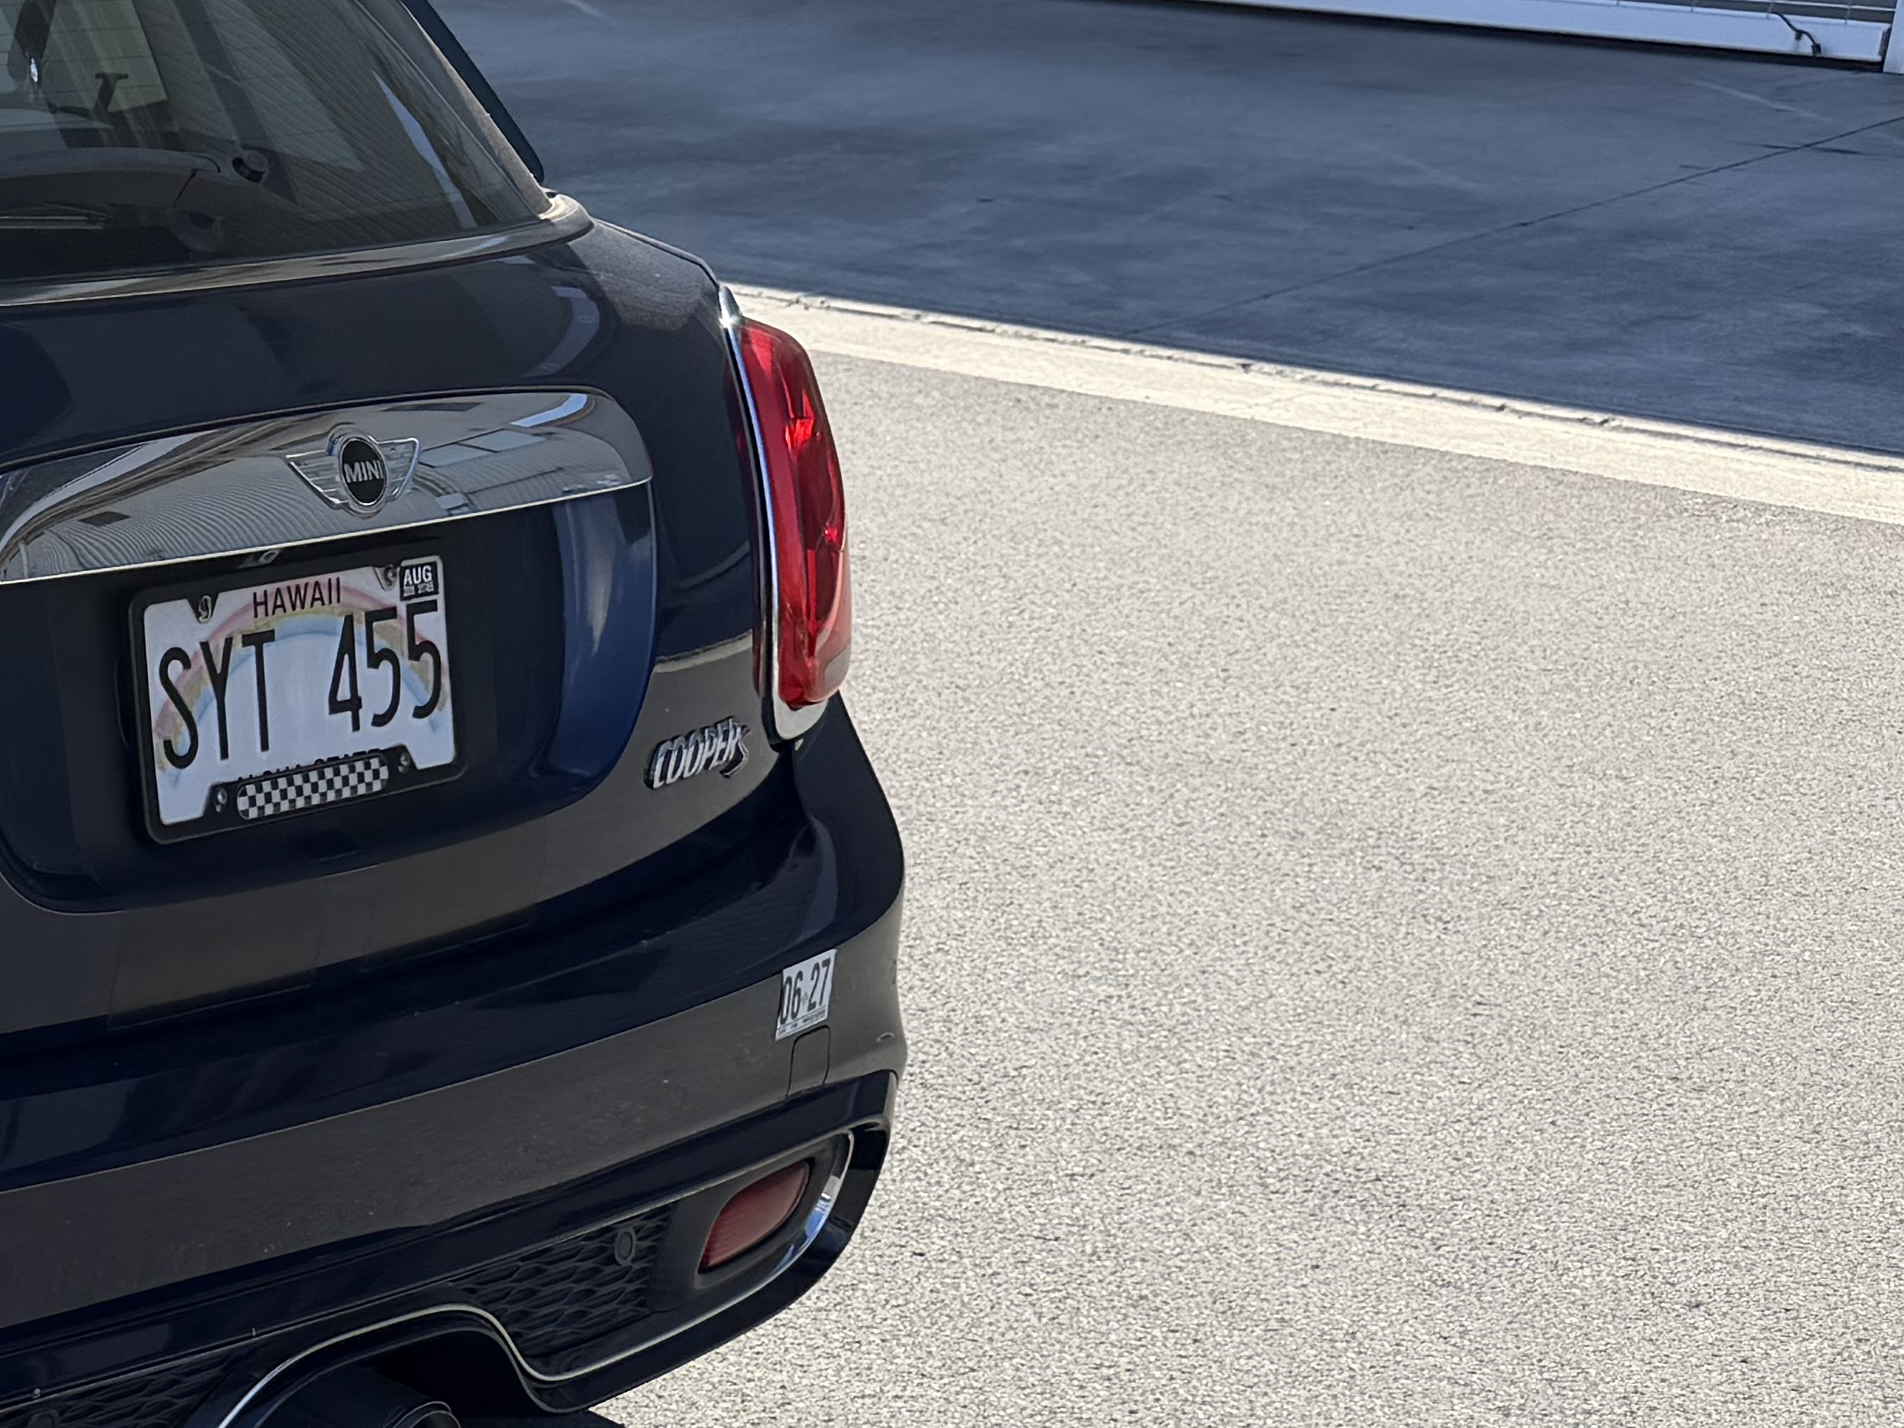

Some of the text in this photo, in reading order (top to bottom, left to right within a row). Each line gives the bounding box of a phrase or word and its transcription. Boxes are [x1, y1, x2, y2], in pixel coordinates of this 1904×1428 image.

[343, 459, 384, 483] MINI
[404, 564, 432, 585] AUG
[252, 577, 342, 619] HAWAII
[158, 599, 442, 770] SYT 455
[780, 970, 804, 1025] 06
[807, 957, 831, 1012] 27
